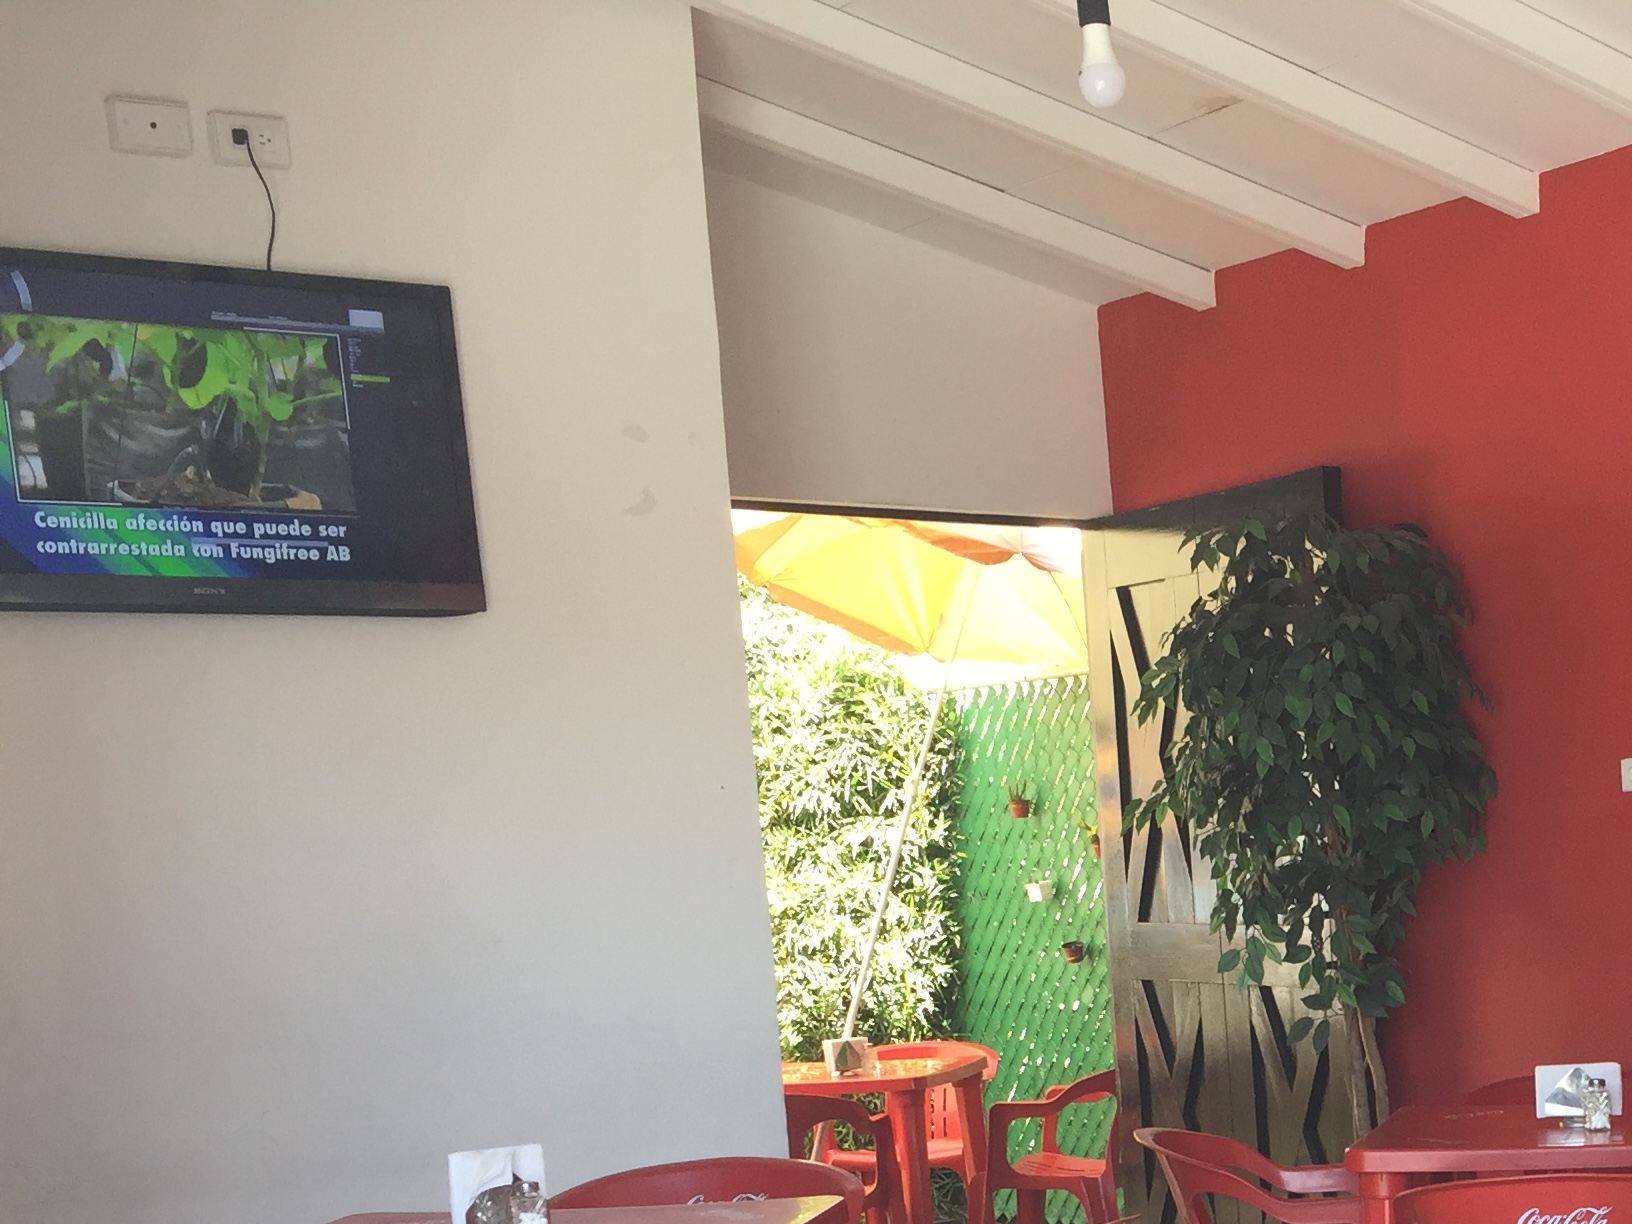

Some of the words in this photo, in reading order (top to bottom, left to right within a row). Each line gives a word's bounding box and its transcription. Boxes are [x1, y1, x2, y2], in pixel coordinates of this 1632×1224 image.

[34, 511, 118, 530] Cenicilla
[125, 512, 203, 533] afección
[210, 520, 247, 538] que
[253, 518, 311, 539] puede
[318, 524, 347, 538] ser
[36, 539, 185, 557] contrarrestada
[192, 542, 224, 558] con
[230, 542, 319, 563] Fungifree
[326, 546, 351, 561] AB
[193, 587, 226, 595] SONY
